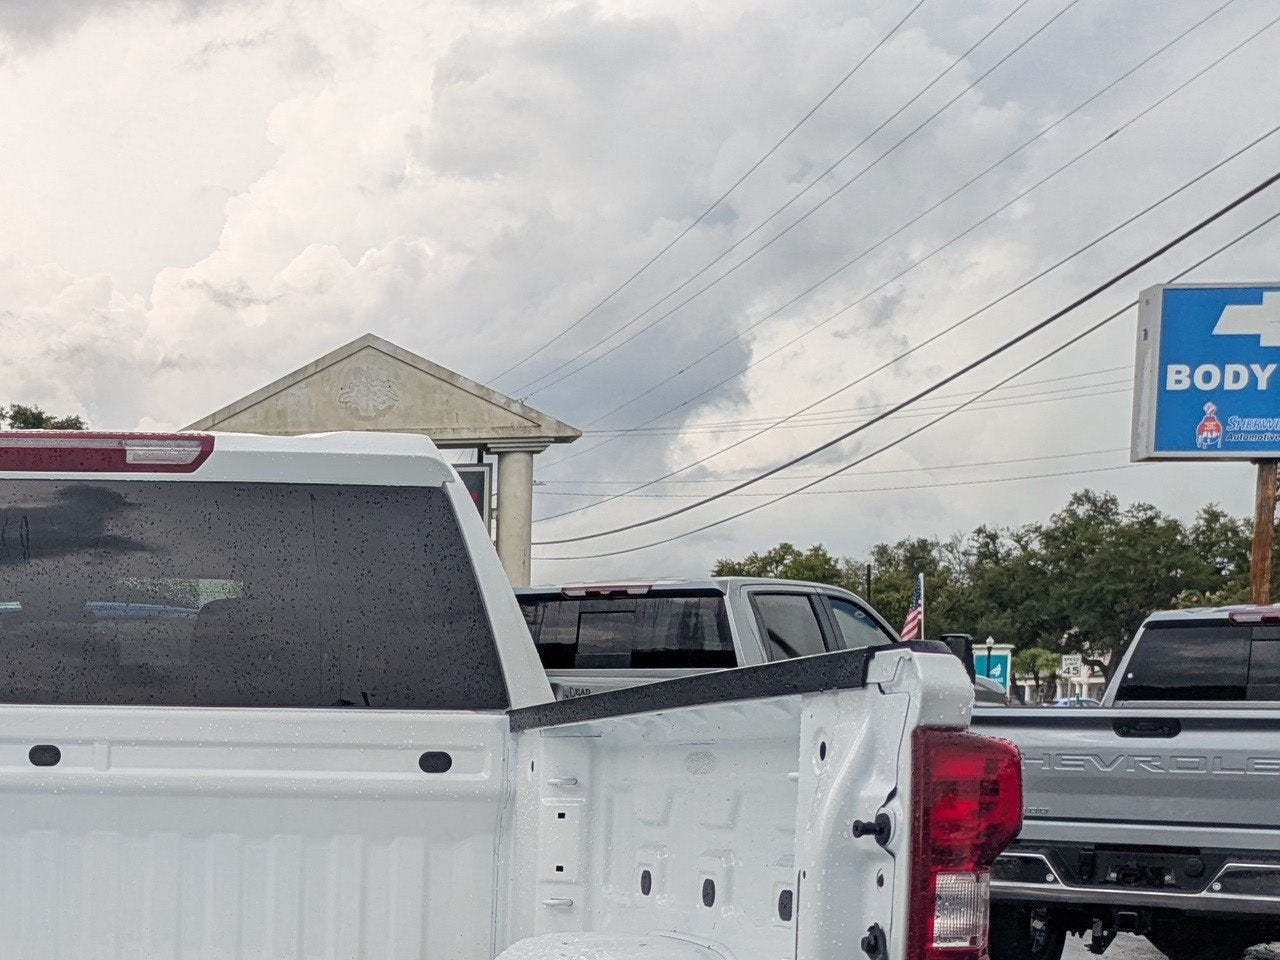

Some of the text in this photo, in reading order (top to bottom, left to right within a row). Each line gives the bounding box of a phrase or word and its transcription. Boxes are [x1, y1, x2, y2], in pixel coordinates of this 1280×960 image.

[1166, 364, 1277, 390] BODY
[1063, 666, 1079, 675] 45
[1021, 753, 1280, 775] HEVROLE
